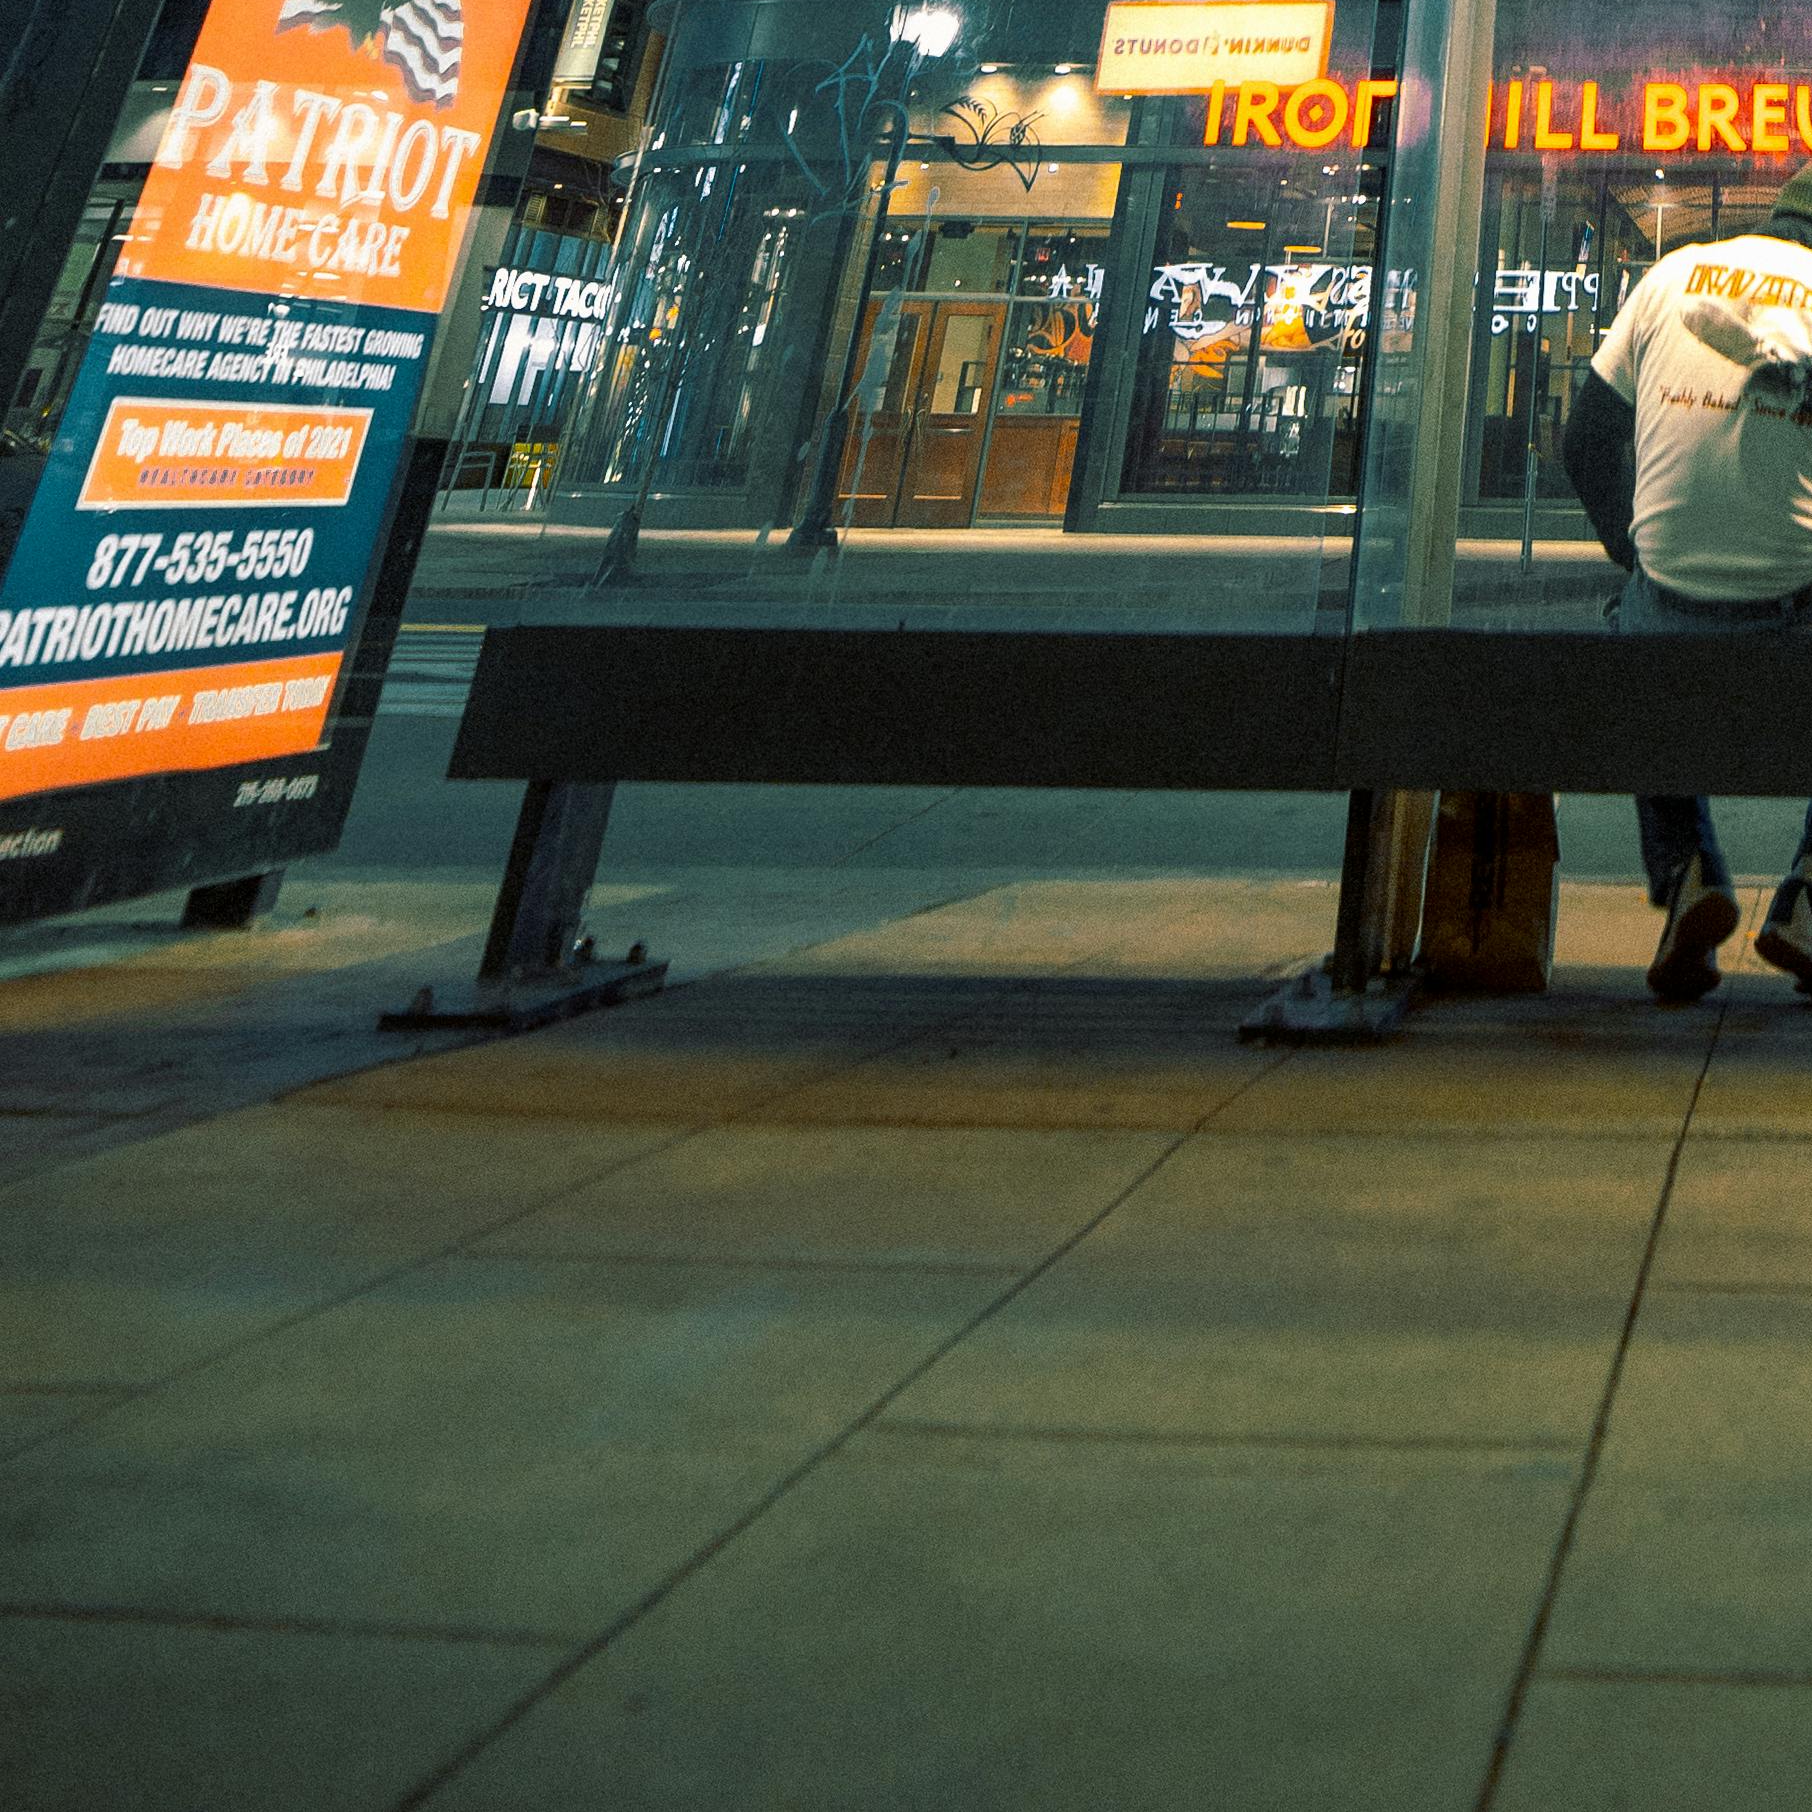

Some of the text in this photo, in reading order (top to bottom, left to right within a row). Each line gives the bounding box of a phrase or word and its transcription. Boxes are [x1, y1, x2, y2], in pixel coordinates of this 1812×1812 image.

[153, 63, 482, 220] PATRIOT
[1485, 79, 1621, 152] ILL
[185, 192, 411, 278] HOME CARE
[94, 302, 425, 360] FIND OUT WHY WE'RE THE FASTEST GROWING
[106, 343, 397, 391] HOMECARE AGENCY IN PHILADELPHIA!
[116, 418, 353, 464] Top Work Places of 2021
[86, 527, 314, 590] 877-535-5550
[4, 707, 72, 751] CARE
[80, 698, 139, 741] BEST
[135, 694, 182, 734] PAY
[188, 681, 283, 725] TRANSFER
[280, 674, 332, 712] TODAY
